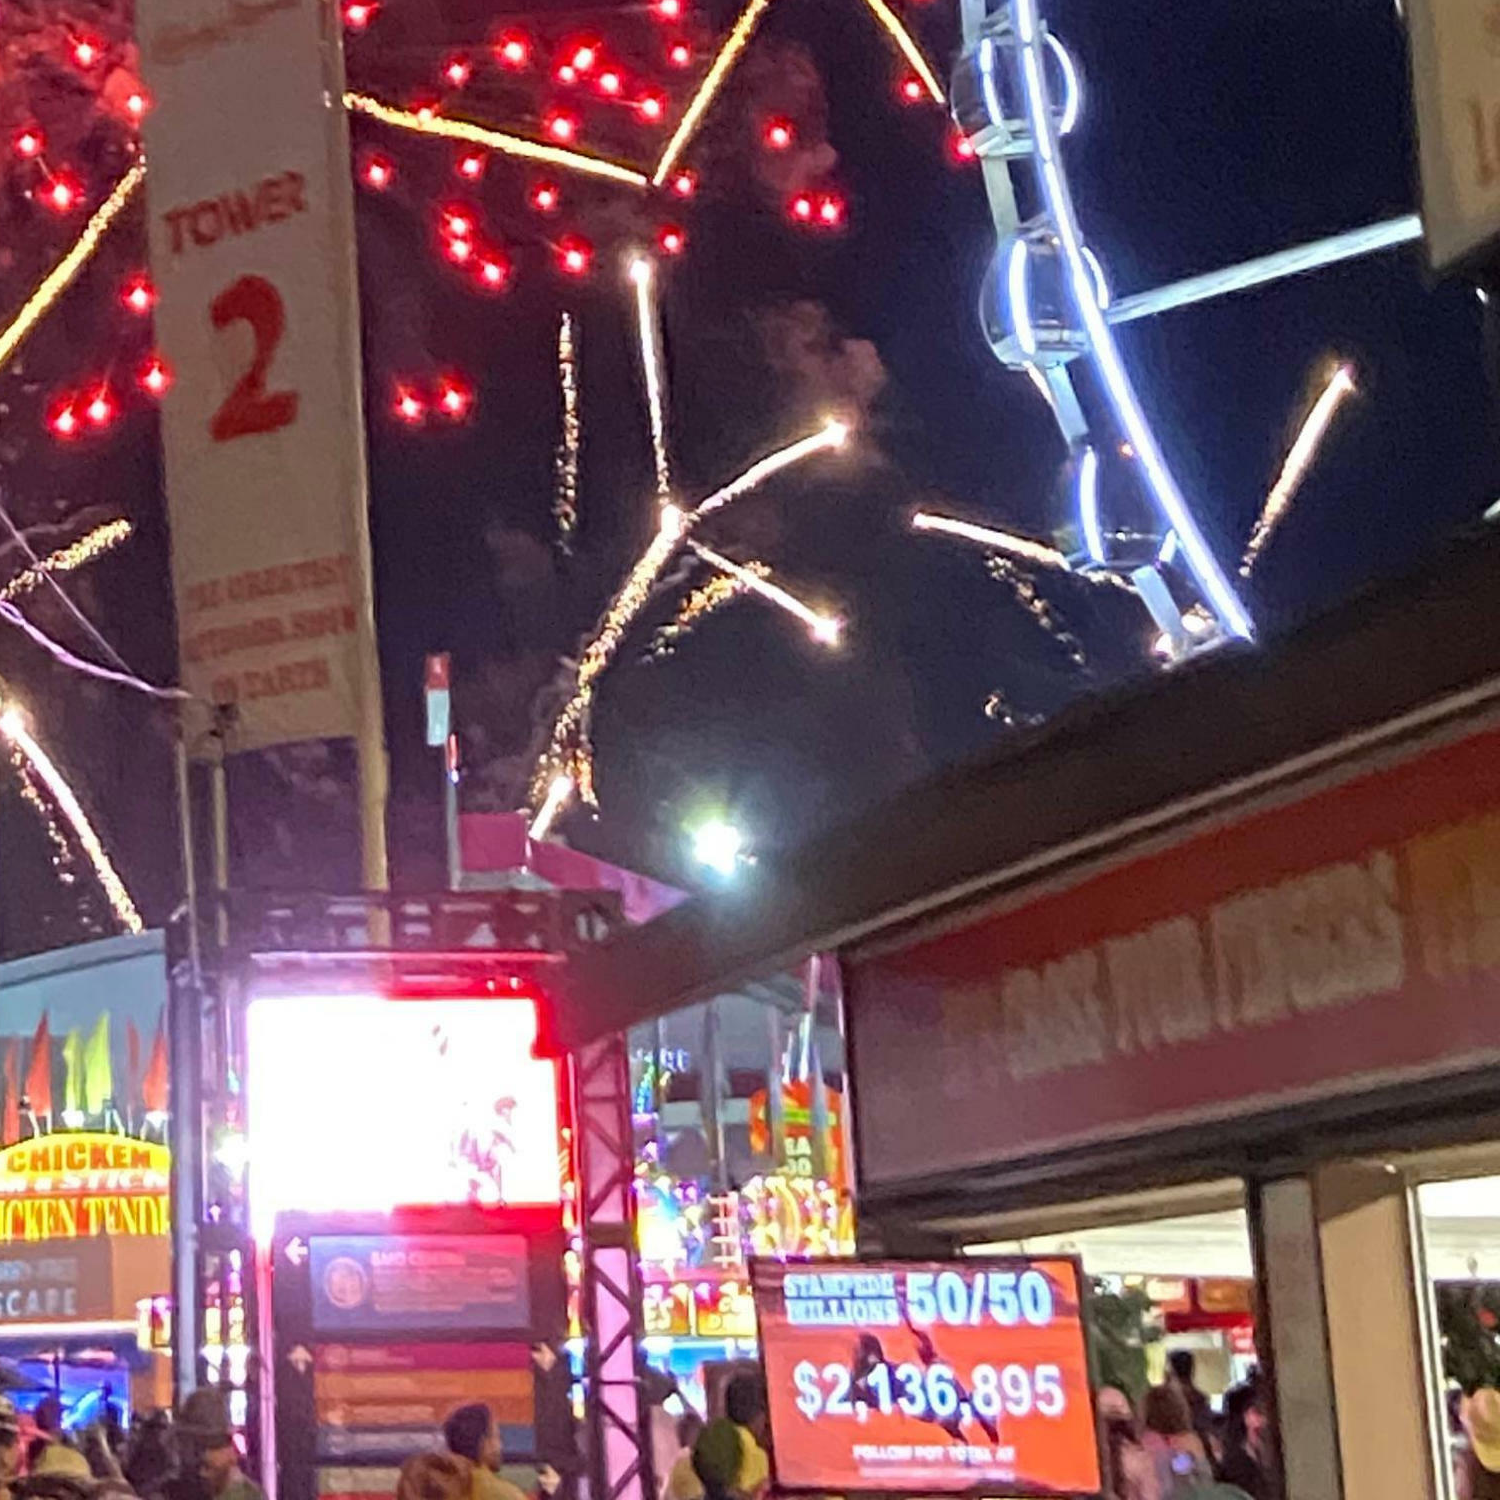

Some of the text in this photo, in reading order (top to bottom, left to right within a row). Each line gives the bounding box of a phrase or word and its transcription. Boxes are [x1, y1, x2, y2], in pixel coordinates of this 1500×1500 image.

[162, 169, 305, 254] TOWER
[209, 274, 298, 443] 2
[7, 1142, 150, 1172] CHICKEN
[906, 1270, 1053, 1326] 50/50
[793, 1360, 1066, 1426] $2,136,895
